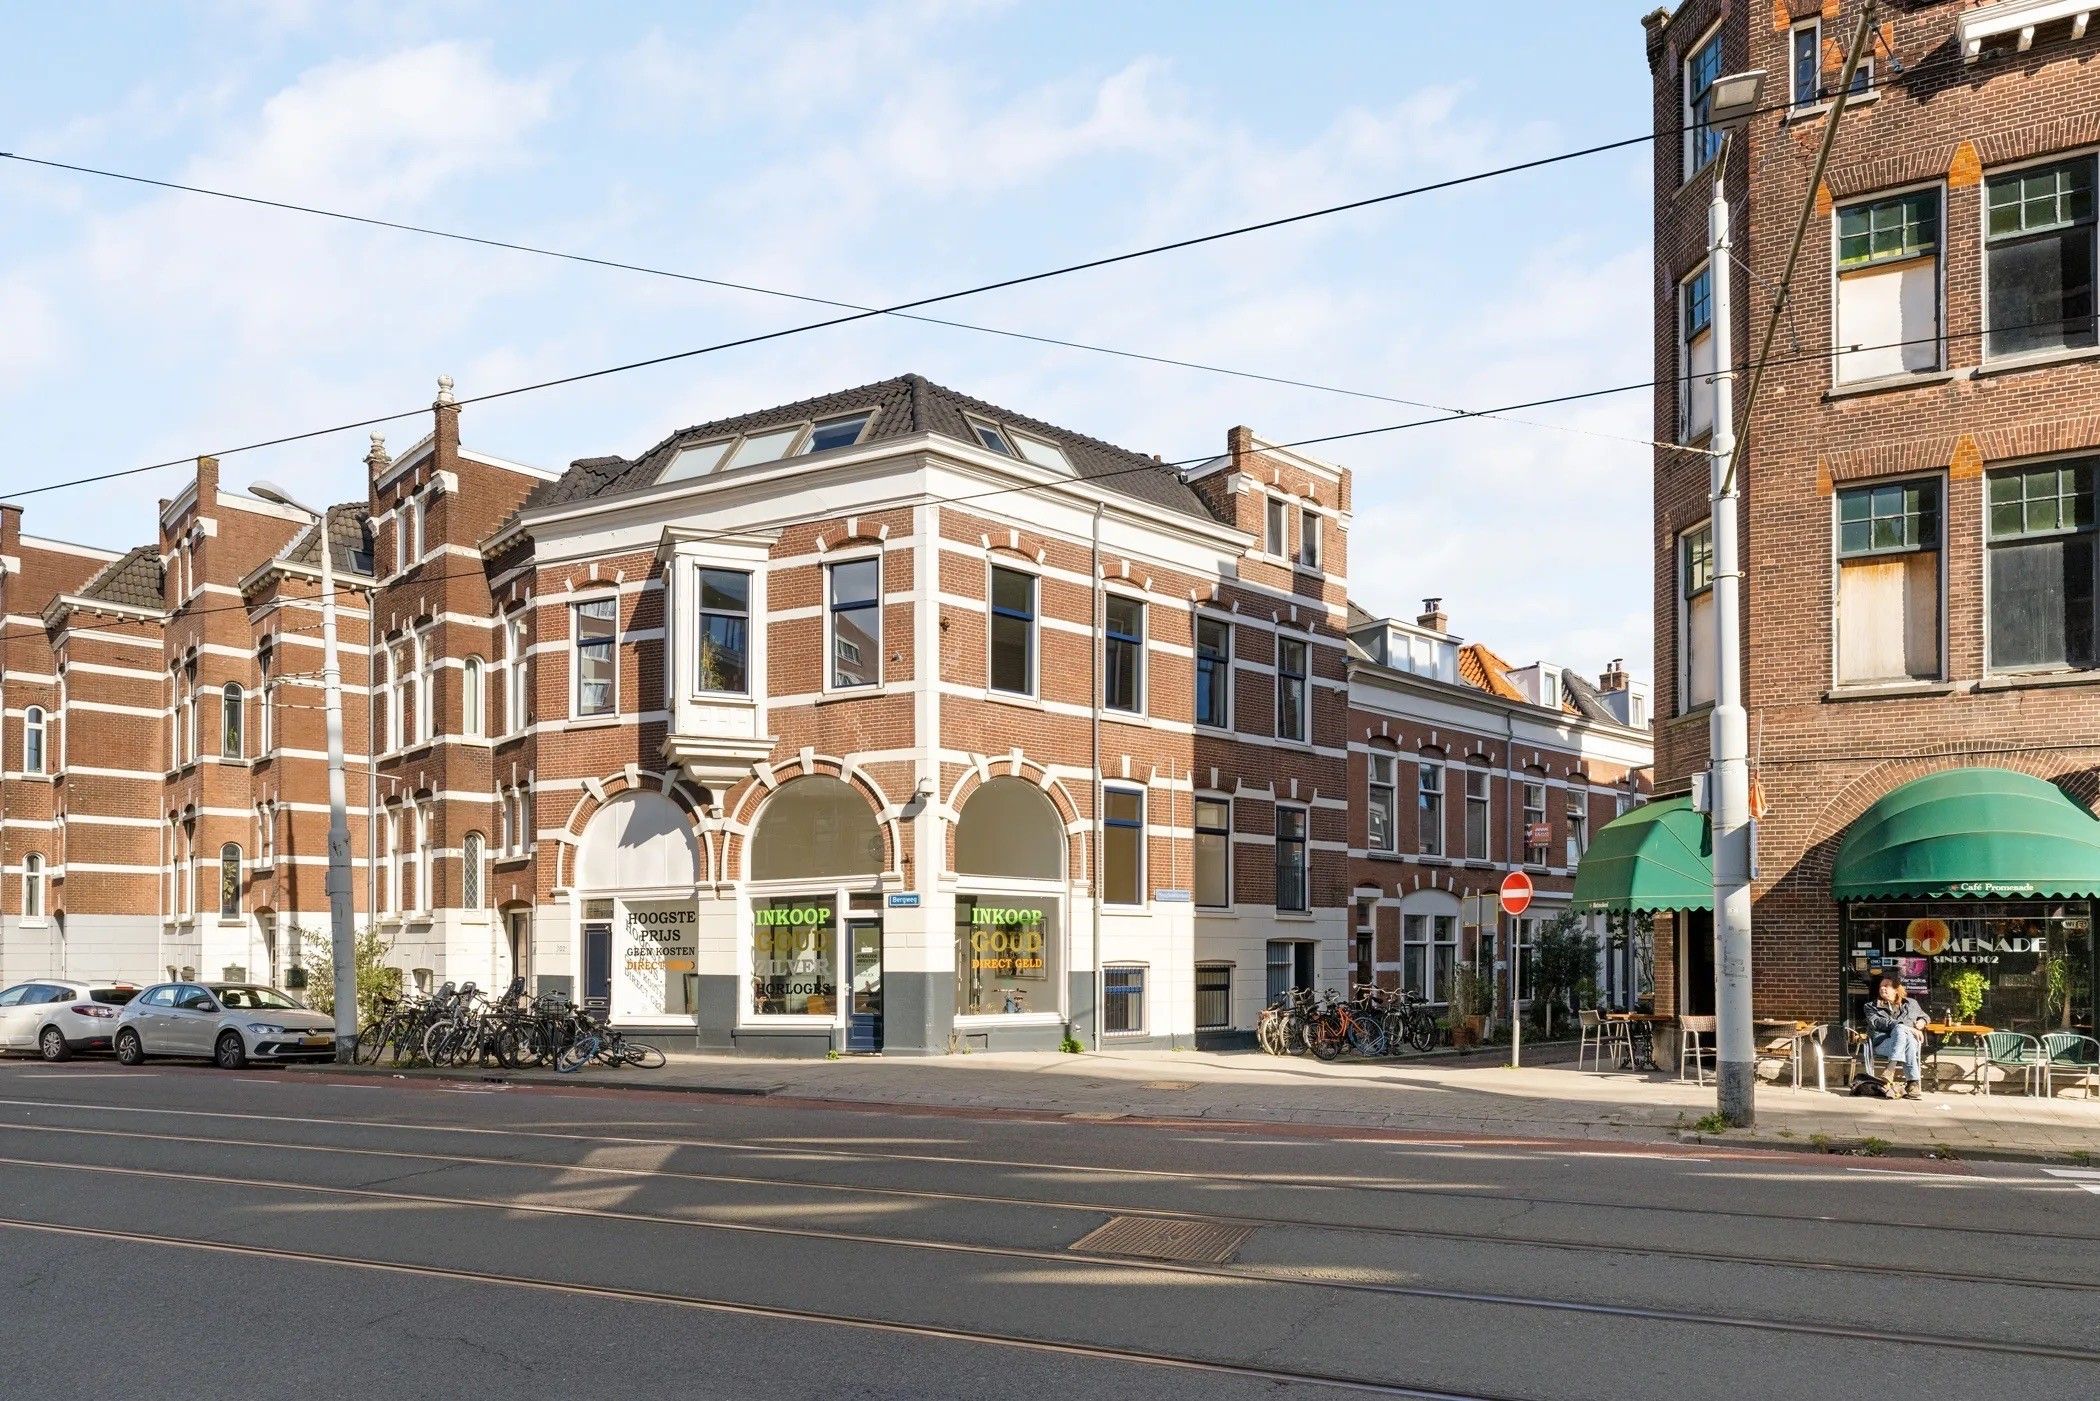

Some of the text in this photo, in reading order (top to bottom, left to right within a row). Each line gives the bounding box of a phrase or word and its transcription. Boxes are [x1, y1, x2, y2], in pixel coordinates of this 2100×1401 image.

[1960, 882, 2034, 891] Café Promenade
[628, 910, 696, 925] HOOGSTE
[755, 907, 831, 926] INKOOP
[972, 907, 1043, 926] INKOOP
[641, 929, 681, 942] PRIJS
[755, 930, 832, 952] GOUD
[971, 930, 1041, 953] GOUD
[627, 946, 695, 956] GEEN KOSTEN
[1888, 937, 2048, 953] PROMENADE
[626, 961, 665, 971] DIRECT
[971, 958, 1043, 969] DIRECT GELD
[1933, 955, 1999, 963] SINDS 1902
[756, 959, 832, 976] ZILVER
[755, 983, 830, 995] HORLOGES
